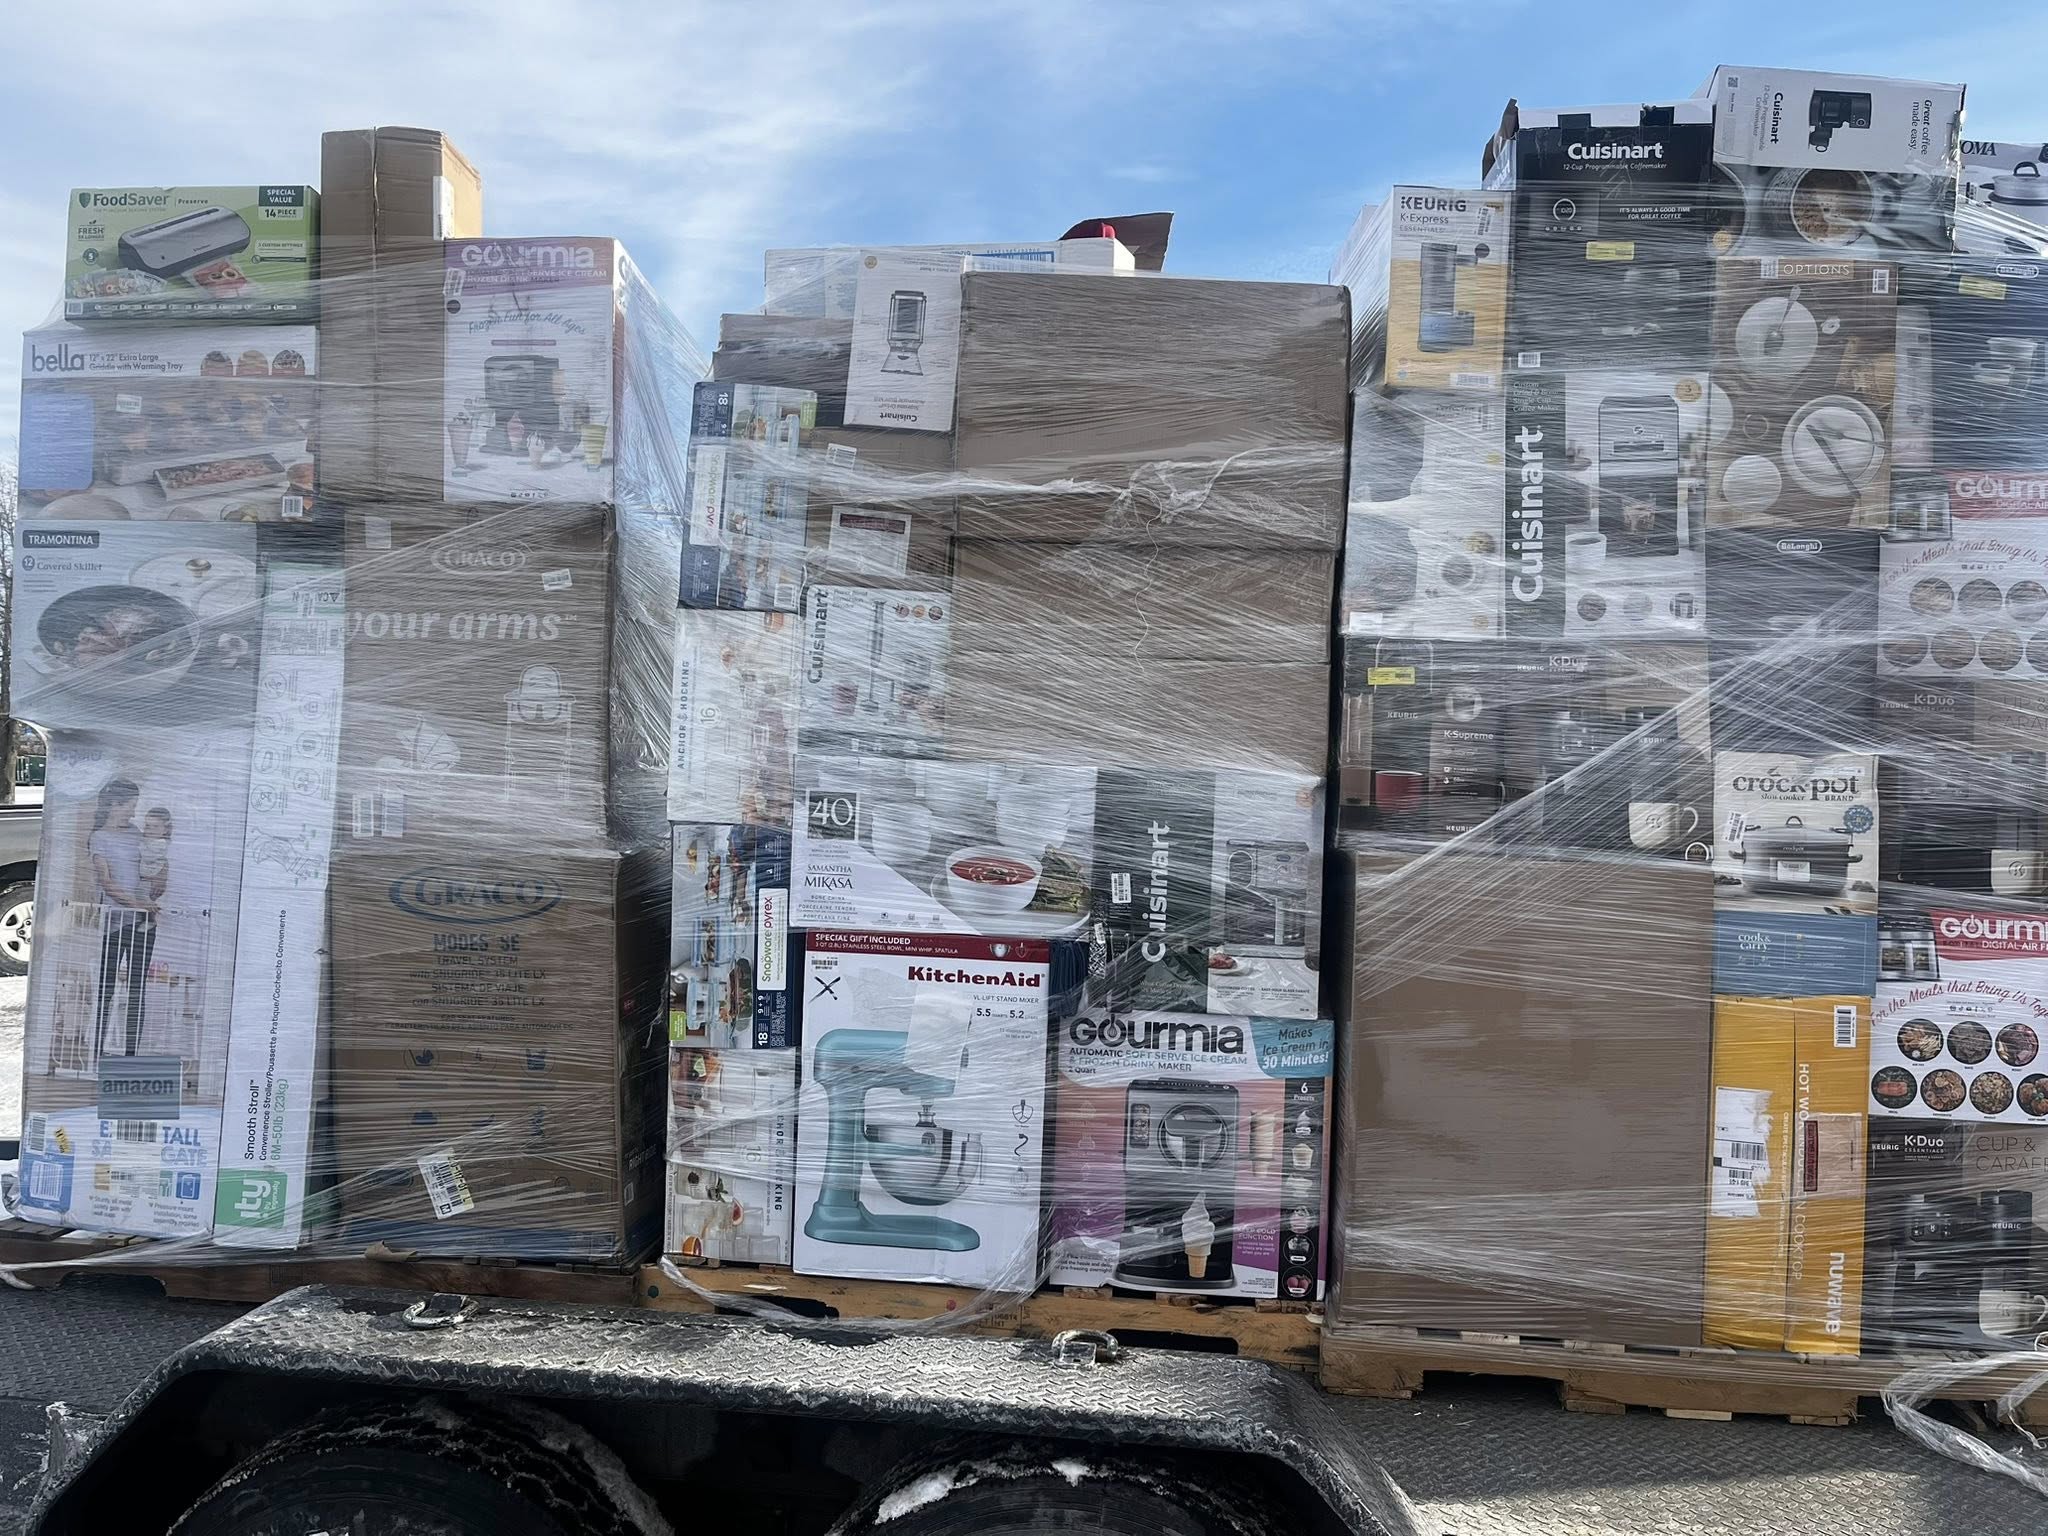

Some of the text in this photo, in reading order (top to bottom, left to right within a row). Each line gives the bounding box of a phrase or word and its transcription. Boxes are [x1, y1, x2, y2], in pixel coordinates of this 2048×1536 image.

[1753, 97, 1762, 137] Coffeemaker
[1770, 92, 1784, 144] Cuisinart
[1912, 101, 1920, 121] made
[1758, 106, 1769, 151] Programmable
[1920, 99, 1932, 155] Great coffee
[1567, 142, 1663, 160] Cuisinart
[1960, 140, 1997, 156] OMA
[1563, 163, 1583, 171] 12-Cup
[1585, 163, 1628, 172] Programmable
[93, 193, 169, 206] FoodSaver
[1400, 196, 1467, 212] KEURIG
[264, 208, 276, 218] 14
[1783, 263, 1850, 275] OPTIONS
[32, 344, 85, 372] bella
[139, 353, 159, 363] Large
[718, 392, 728, 405] 18
[879, 412, 918, 422] Cuisinart
[1512, 425, 1545, 602] Cuisinart
[28, 534, 94, 545] TRAMONTINA
[37, 561, 72, 571] Covered
[807, 588, 829, 684] Cuisinart
[676, 660, 690, 770] ANCHOR HOCKING
[699, 708, 716, 724] 16
[810, 797, 854, 826] 40
[807, 863, 852, 873] SAMANTHA
[804, 875, 853, 891] MIKASA
[1141, 820, 1170, 963] Cuisinart
[761, 897, 773, 982] Snapware pyrex
[815, 933, 911, 945] SPECIAL GIFT INCLUDED
[1982, 941, 2019, 949] DIGITAL
[2021, 942, 2038, 951] AIR
[1740, 943, 1768, 952] carry
[908, 966, 1041, 988] KitchenAid
[1909, 983, 1944, 1002] Meals
[1947, 980, 1974, 993] that
[1975, 981, 2011, 1003] Bring
[976, 1008, 1025, 1019] 5.5 5.2
[757, 1032, 768, 1046] 18
[1278, 1027, 1313, 1039] Makes
[1069, 1047, 1124, 1058] AUTOMATIC
[1154, 1052, 1189, 1061] SERVE
[1190, 1053, 1208, 1063] ICE
[1209, 1055, 1248, 1064] CREAM
[1262, 1045, 1278, 1055] Ice
[1280, 1042, 1316, 1054] Cream
[1122, 1059, 1156, 1069] DRINK
[1158, 1062, 1192, 1071] MAKER
[1262, 1052, 1329, 1069] 30 Minutes!
[263, 1037, 278, 1108] Stroller/Poussette
[1074, 1067, 1097, 1075] Quart
[1798, 1063, 1809, 1093] HOT
[102, 1079, 174, 1095] amazon
[1300, 1082, 1307, 1093] 6
[274, 1079, 289, 1113] (23kg)
[161, 1126, 202, 1146] TALL
[244, 1117, 257, 1160] Smooth
[259, 1110, 271, 1161] Convenience
[1976, 1136, 2036, 1151] CUP &
[1791, 1215, 1806, 1280] COOKTOP
[1825, 1252, 1846, 1335] nuwave
